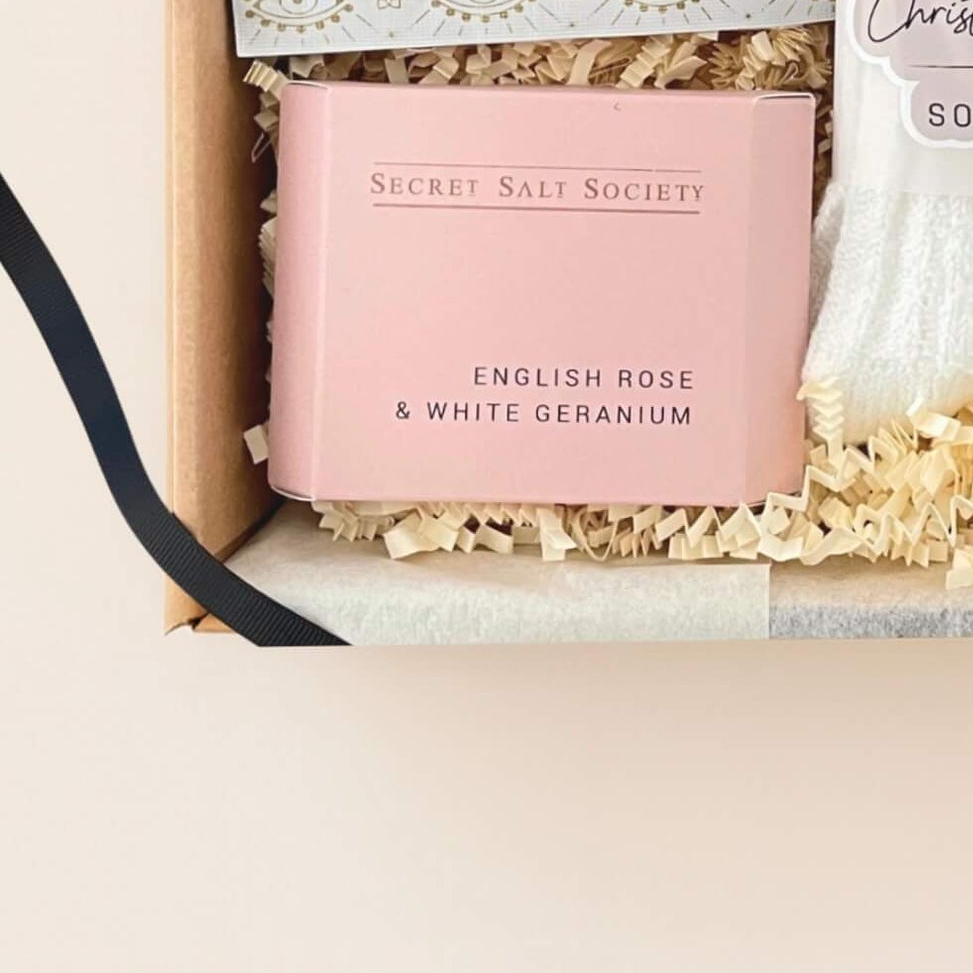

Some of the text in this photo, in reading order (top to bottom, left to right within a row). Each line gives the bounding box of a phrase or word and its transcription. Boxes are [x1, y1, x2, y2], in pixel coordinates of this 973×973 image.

[473, 367, 694, 389] ENGLISH ROSE
[396, 401, 691, 425] & WHITE GERANIUM
